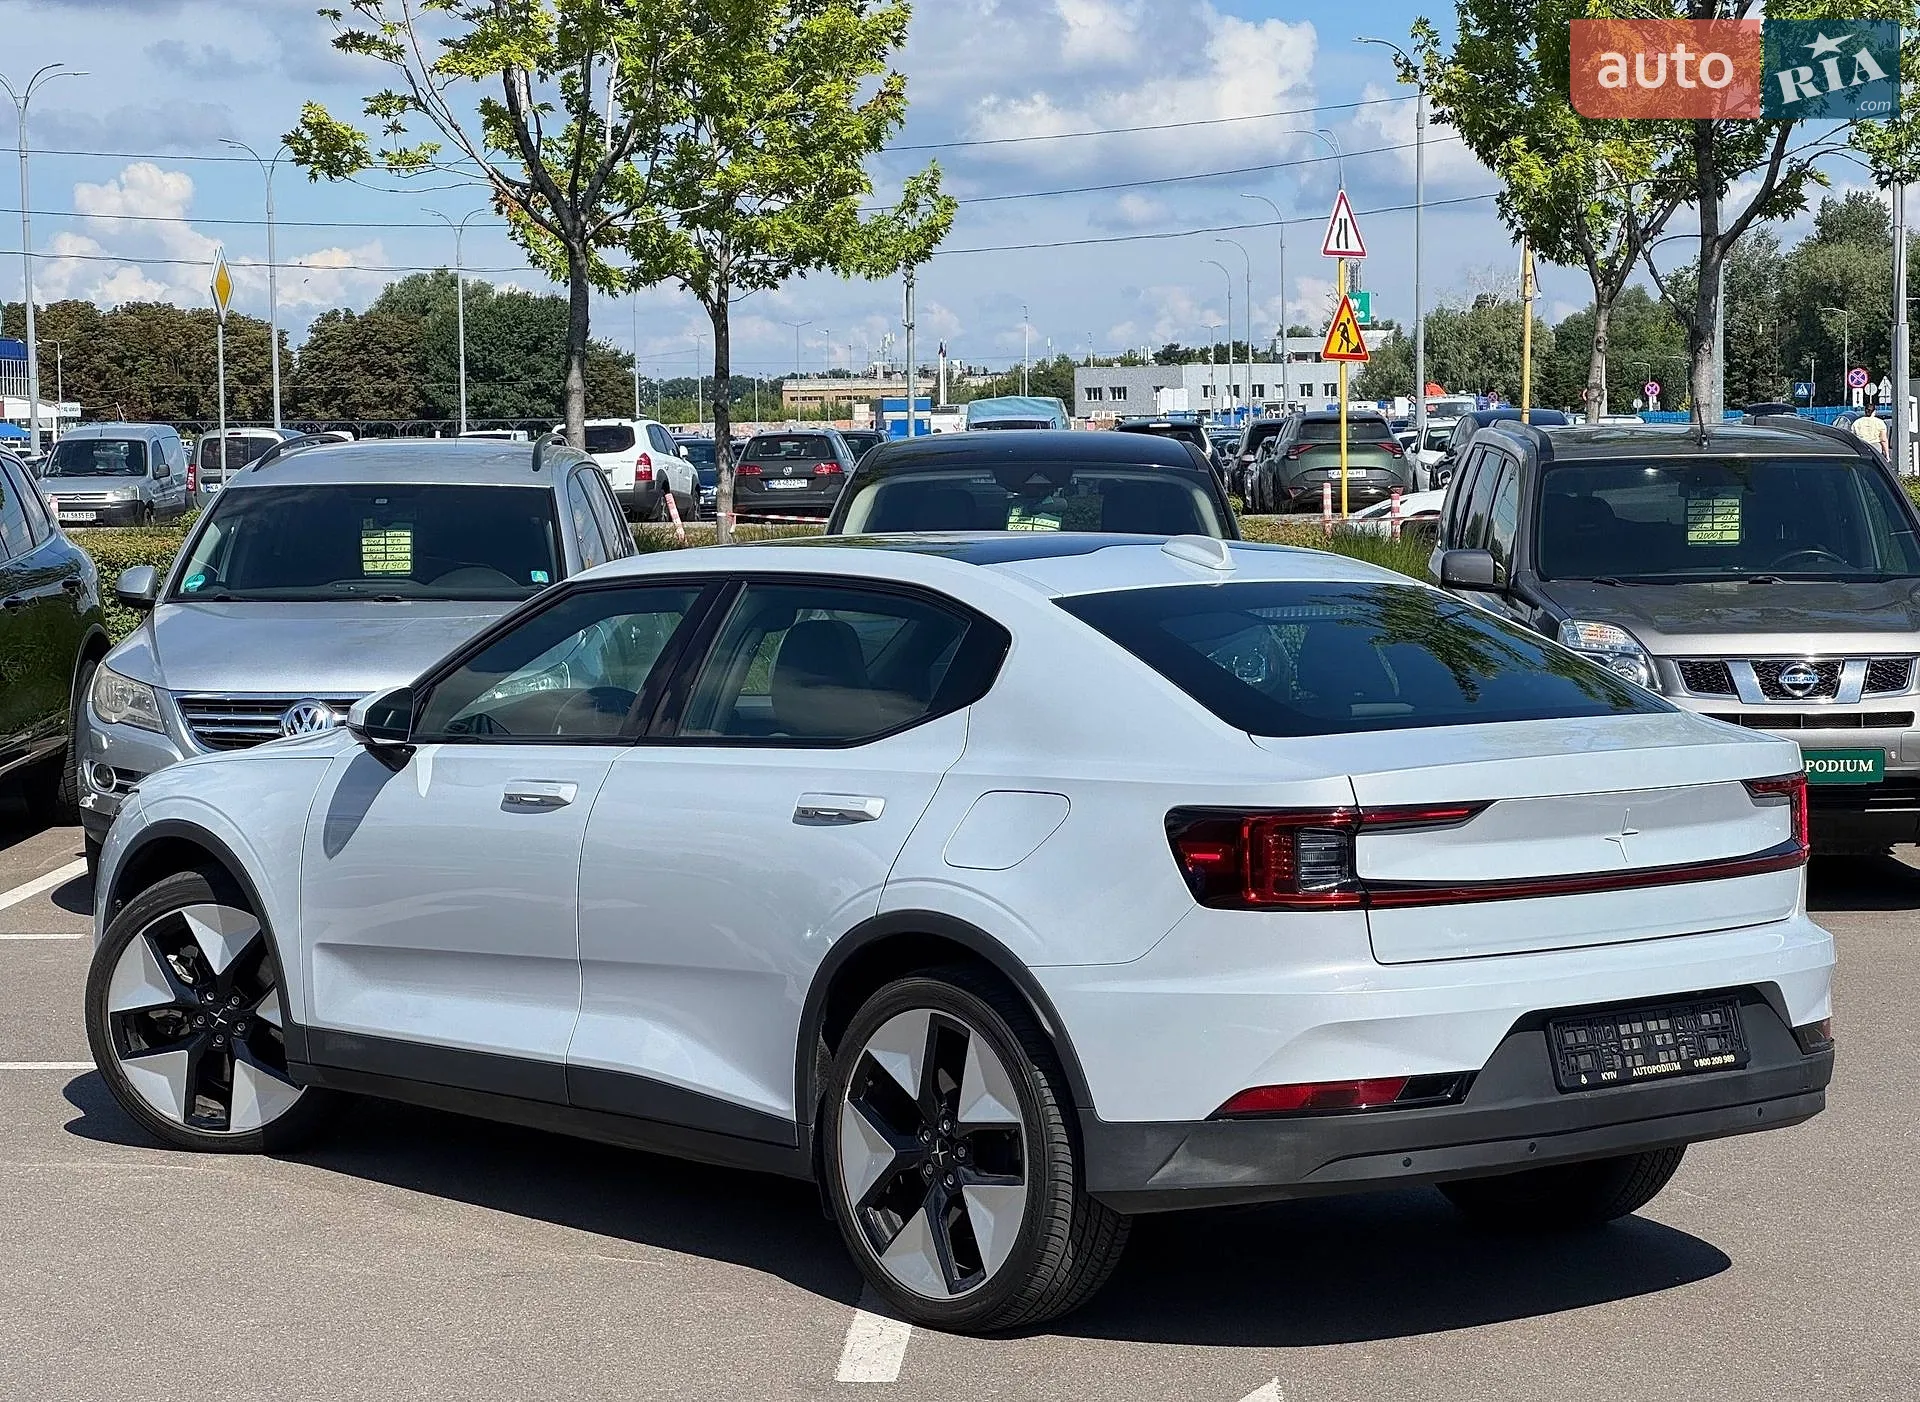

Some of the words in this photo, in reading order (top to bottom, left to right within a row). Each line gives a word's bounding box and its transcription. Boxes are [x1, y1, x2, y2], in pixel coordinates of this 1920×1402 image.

[1805, 759, 1874, 773] PODIUM
[1601, 1070, 1618, 1081] KYIV
[1632, 1061, 1682, 1077] AUTOPODIUM
